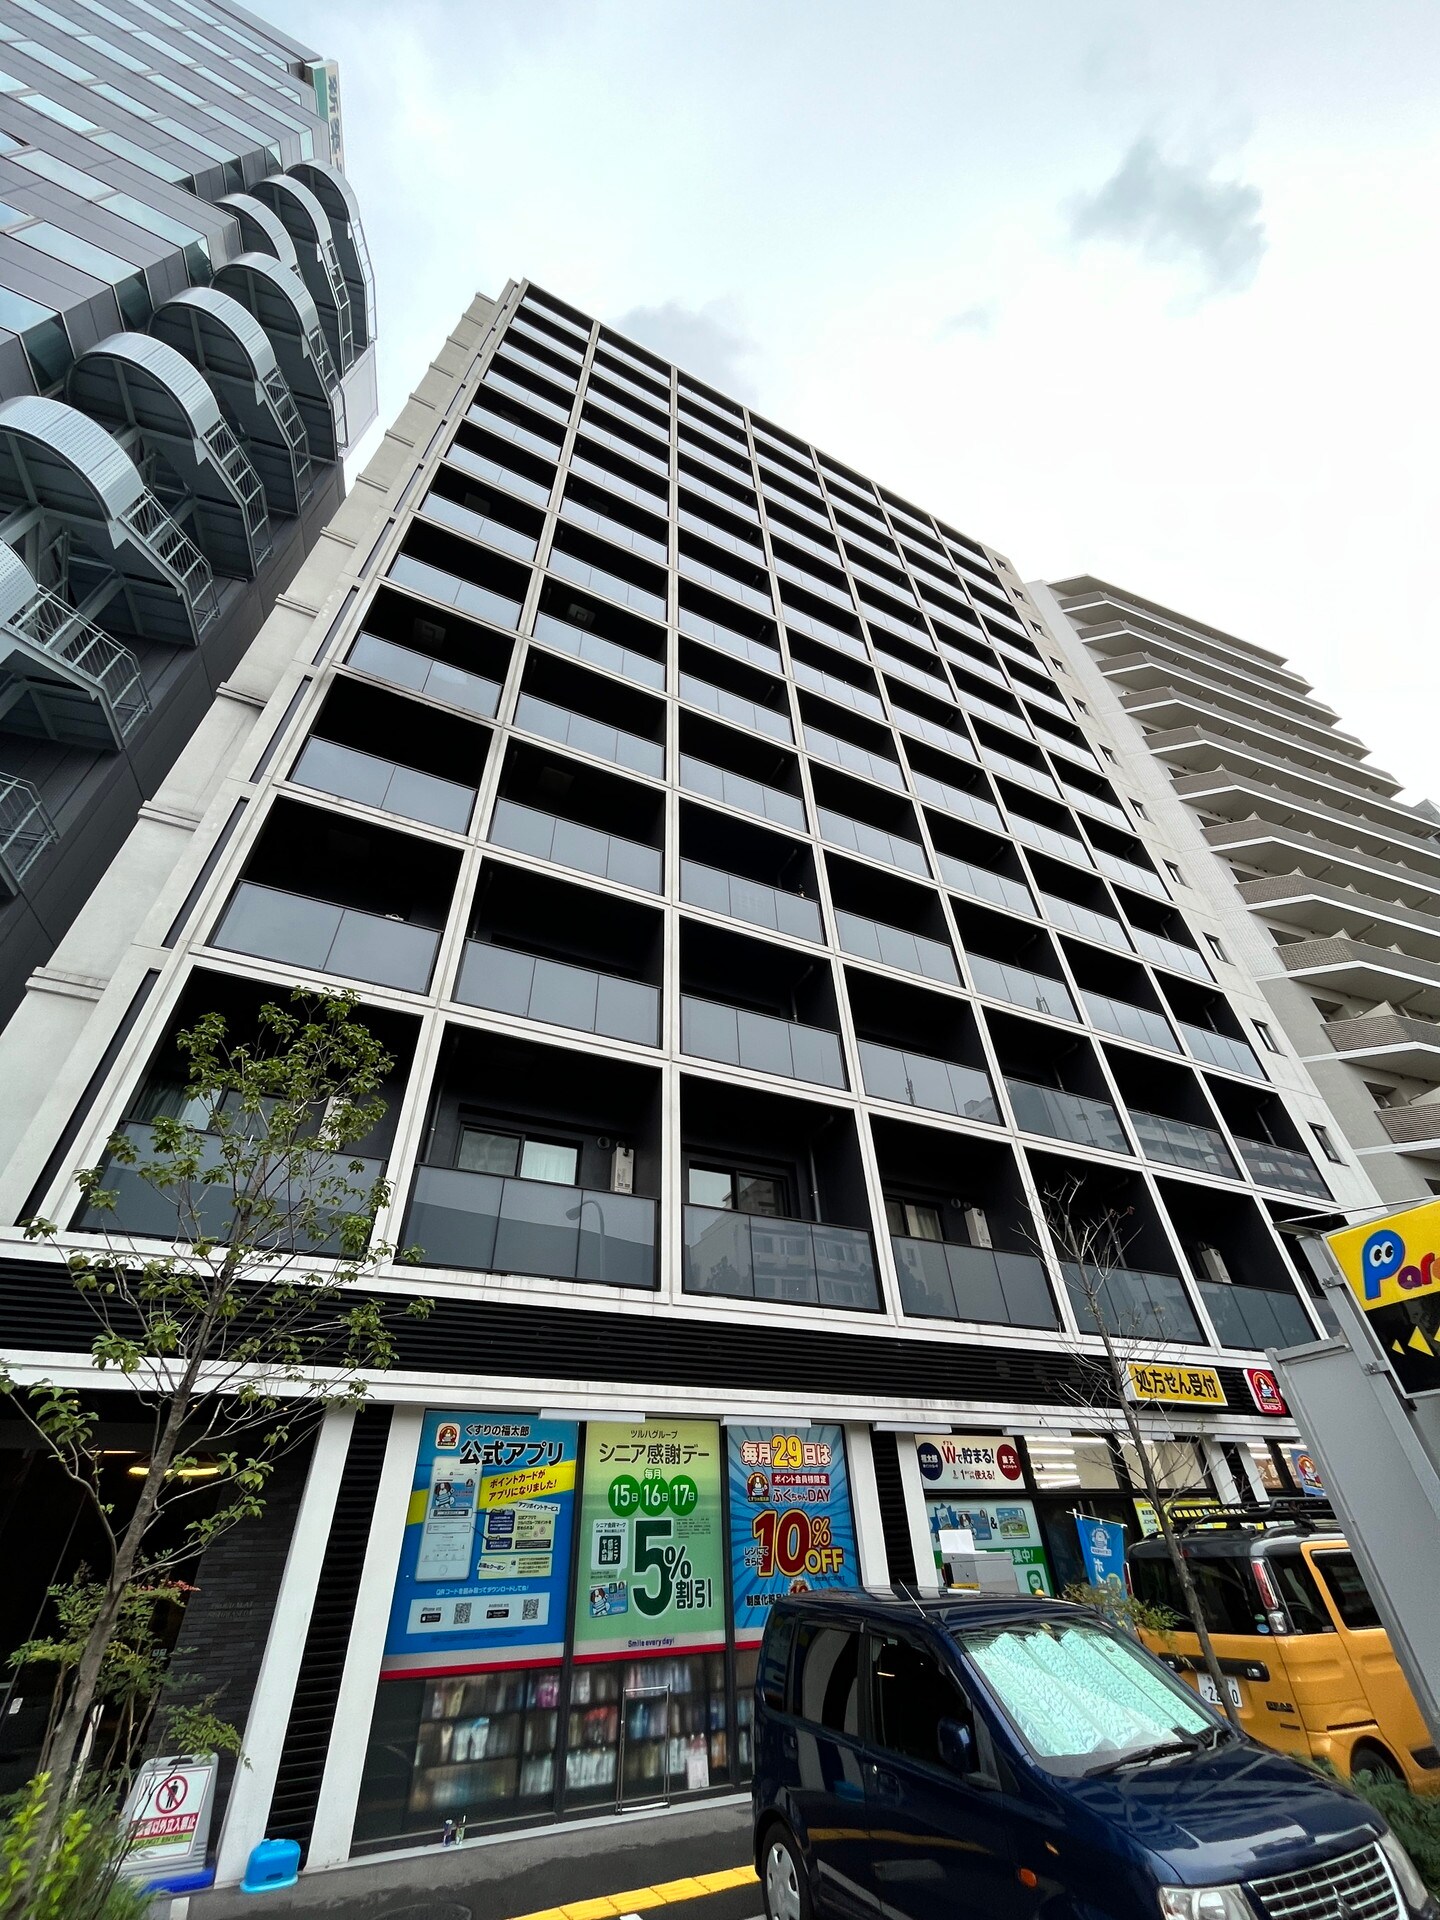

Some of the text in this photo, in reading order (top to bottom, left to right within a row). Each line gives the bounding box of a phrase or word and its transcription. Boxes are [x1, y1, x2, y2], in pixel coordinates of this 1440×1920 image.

[1134, 1368, 1218, 1398] 処方せん受付
[466, 1424, 531, 1437] くすりの福太郎
[630, 1430, 678, 1439] ツルハグループ
[460, 1440, 563, 1466] 公式アプリ
[599, 1443, 710, 1465] シニア感謝デー
[742, 1434, 831, 1468] 毎月29日は
[941, 1445, 995, 1464] Wで貯まる!
[490, 1469, 546, 1489] ポイントカードが
[644, 1468, 661, 1479] 毎月
[774, 1475, 827, 1484] ポイント会員様限定
[489, 1479, 557, 1501] アプリになりました!
[613, 1485, 638, 1506] 15日
[644, 1485, 668, 1506] 16日
[673, 1484, 695, 1506] 17日
[773, 1489, 831, 1502] ふくちゃんDAY
[744, 1547, 769, 1556] レジにて
[753, 1509, 831, 1576] 10%
[805, 1548, 844, 1574] OFF
[633, 1520, 711, 1616] 5% 割引
[745, 1557, 763, 1566] さらに
[746, 1593, 788, 1607] 制度化粧
[628, 1637, 675, 1647] Smile every day!
